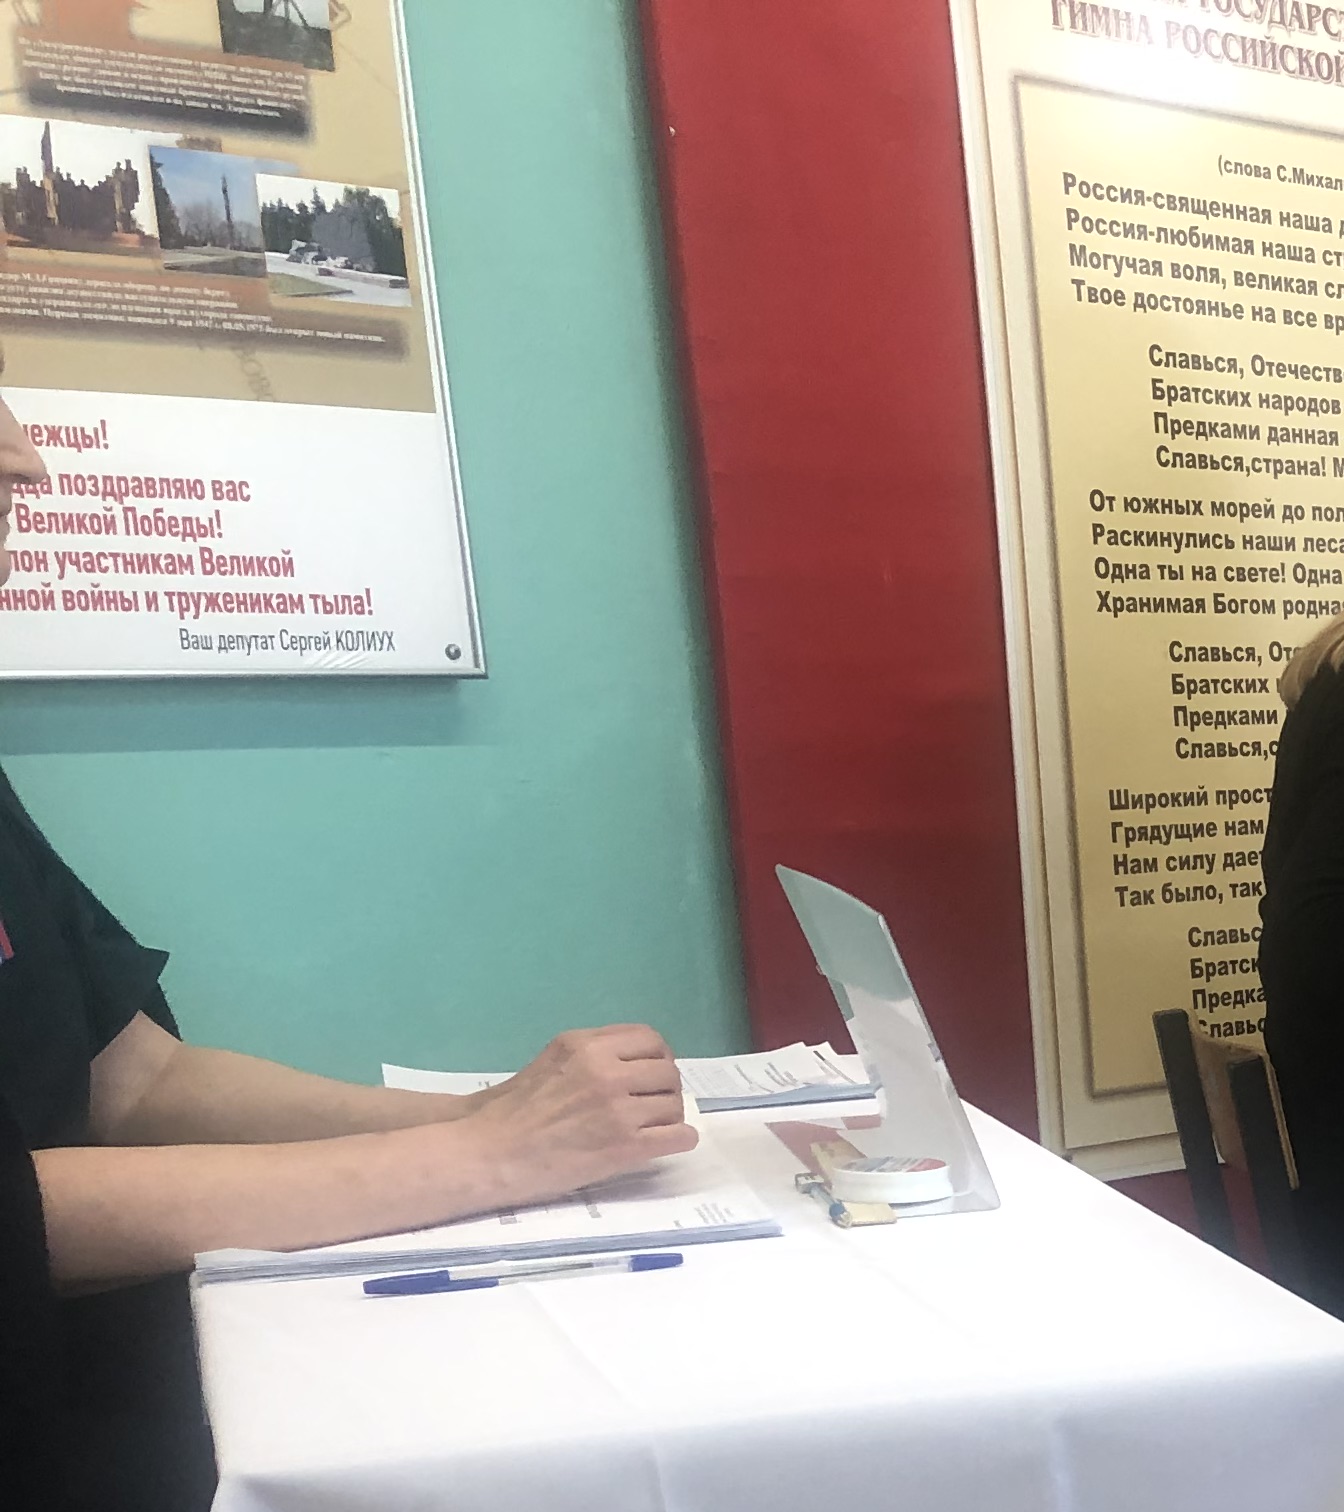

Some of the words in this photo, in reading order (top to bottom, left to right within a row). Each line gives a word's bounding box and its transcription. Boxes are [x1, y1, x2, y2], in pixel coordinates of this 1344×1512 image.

[1051, 0, 1153, 45] ГИМНА
[1218, 155, 1271, 180] (слова
[1062, 172, 1272, 226] Россия-священная
[1279, 211, 1333, 236] наша
[1066, 208, 1255, 256] Россия-любимая
[1262, 241, 1316, 265] наша
[1069, 243, 1163, 278] Могучая
[1170, 263, 1227, 290] воля,
[1233, 269, 1318, 297] великая
[1071, 278, 1126, 307] Твое
[1133, 290, 1245, 321] достоянье
[1251, 304, 1276, 324] на
[1283, 309, 1318, 328] все
[1148, 343, 1245, 380] Славься,
[1151, 378, 1252, 409] Братских
[1258, 392, 1342, 416] народов
[23, 419, 109, 454] ежцы!
[1154, 412, 1261, 441] Предками
[1267, 425, 1339, 448] данная
[58, 473, 206, 505] поздравляю
[211, 479, 251, 502] вас
[1089, 489, 1116, 513] От
[1123, 496, 1204, 516] южных
[1211, 497, 1275, 522] морей
[1282, 507, 1305, 524] до
[14, 503, 117, 536] Великой
[122, 506, 224, 543] Победы!
[1092, 523, 1235, 554] Раскинулись
[1242, 533, 1297, 552] наши
[54, 550, 195, 580] участникам
[200, 547, 295, 578] Великой
[1094, 556, 1151, 583] Одна
[1157, 564, 1184, 581] ты
[1191, 563, 1217, 582] на
[1223, 562, 1286, 584] свете!
[1292, 562, 1342, 587] Одна
[62, 583, 140, 613] войны
[145, 591, 159, 612] и
[164, 590, 304, 620] труженикам
[309, 588, 374, 617] тыла!
[1096, 590, 1206, 618] Хранимая
[1213, 593, 1276, 615] Богом
[179, 628, 213, 652] Ваш
[217, 630, 275, 656] депутат
[279, 628, 332, 656] Сергей
[335, 629, 396, 653] КОЛИУХ
[1169, 640, 1262, 667] Славься,
[1171, 673, 1269, 700] Братских
[1173, 705, 1278, 732] Предками
[1109, 785, 1209, 814] Широкий
[1111, 821, 1218, 848] Грядущие
[1224, 819, 1264, 836] нам
[1113, 853, 1159, 876] Нам
[1165, 853, 1216, 875] силу
[1222, 850, 1263, 871] дае
[1115, 885, 1155, 908] Так
[1161, 882, 1223, 905] было,
[1229, 880, 1263, 899] так
